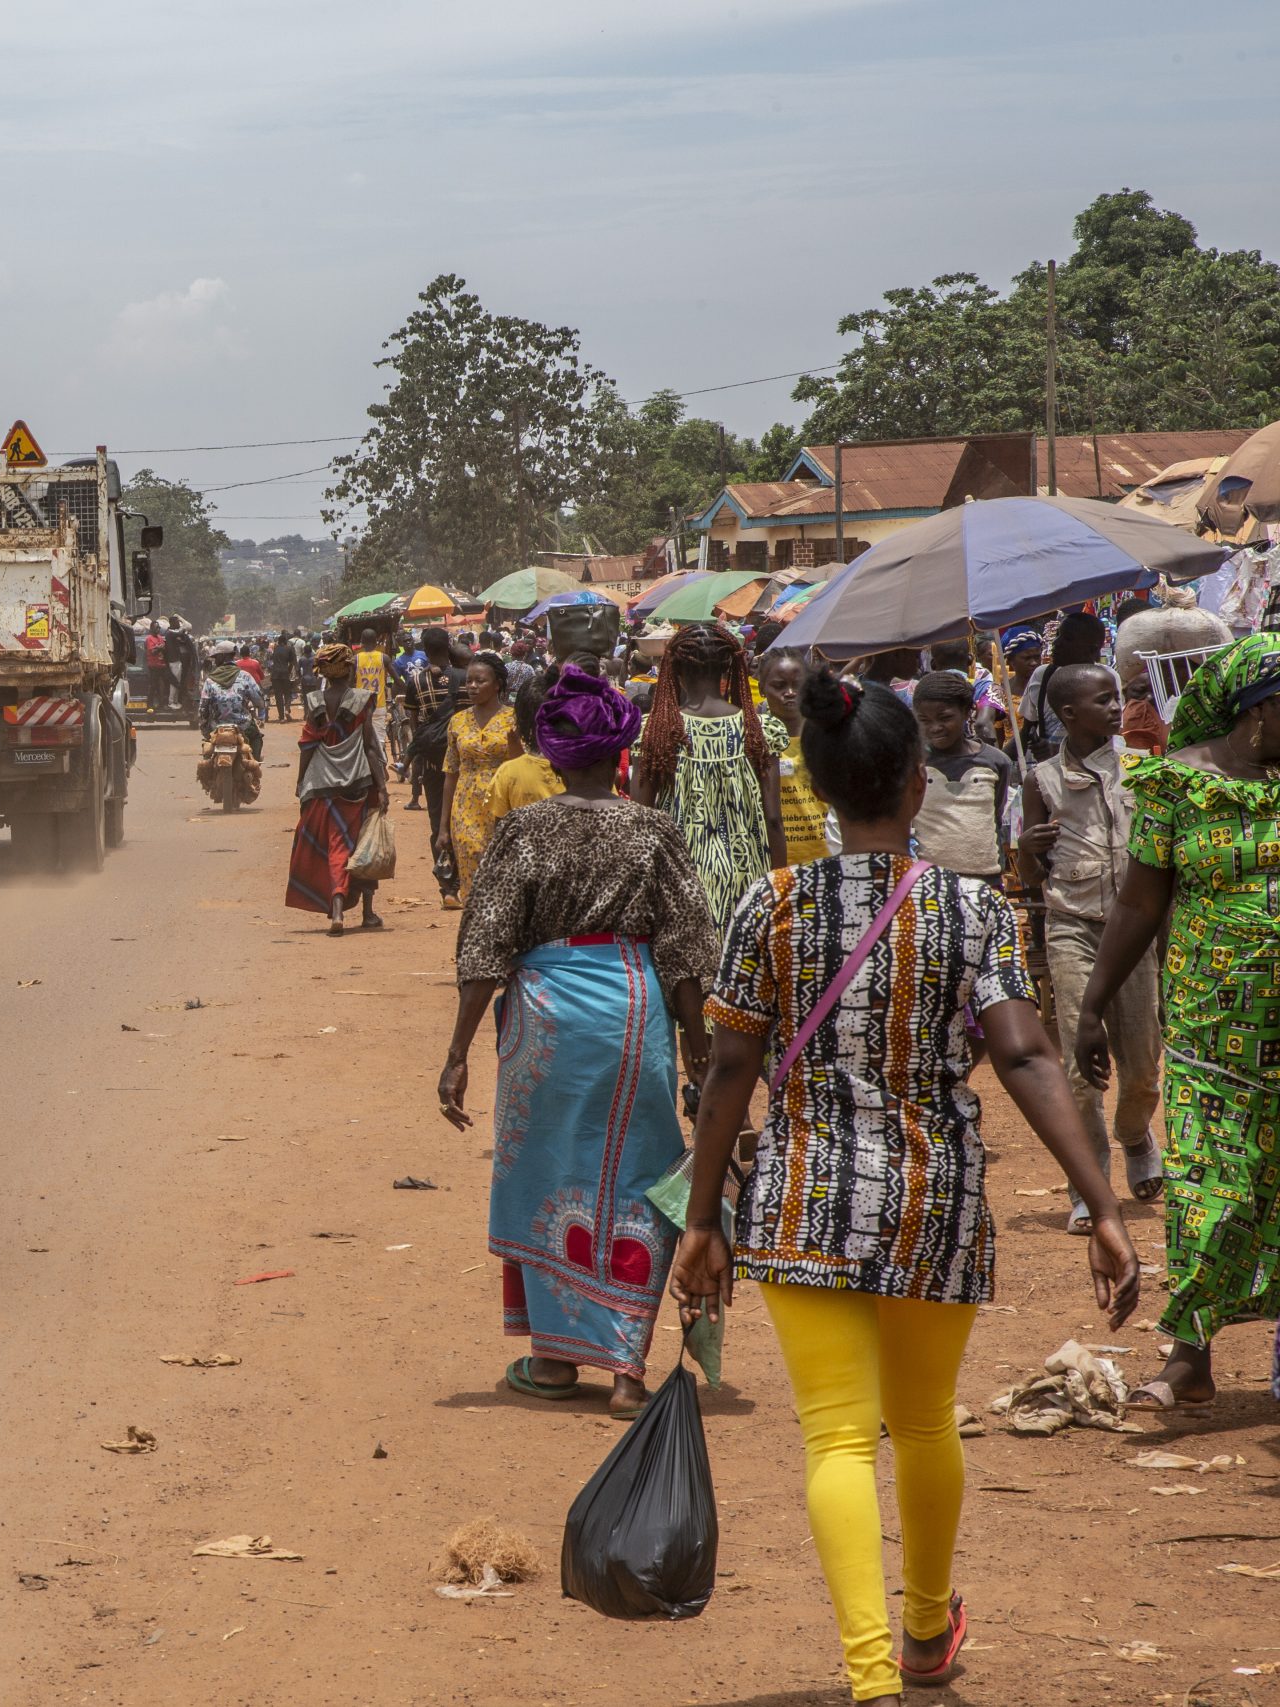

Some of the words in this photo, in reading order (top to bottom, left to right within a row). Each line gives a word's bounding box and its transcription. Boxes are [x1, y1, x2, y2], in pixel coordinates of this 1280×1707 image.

[361, 677, 379, 692] 24
[15, 752, 56, 761] Mercedes
[786, 833, 817, 842] Africain
